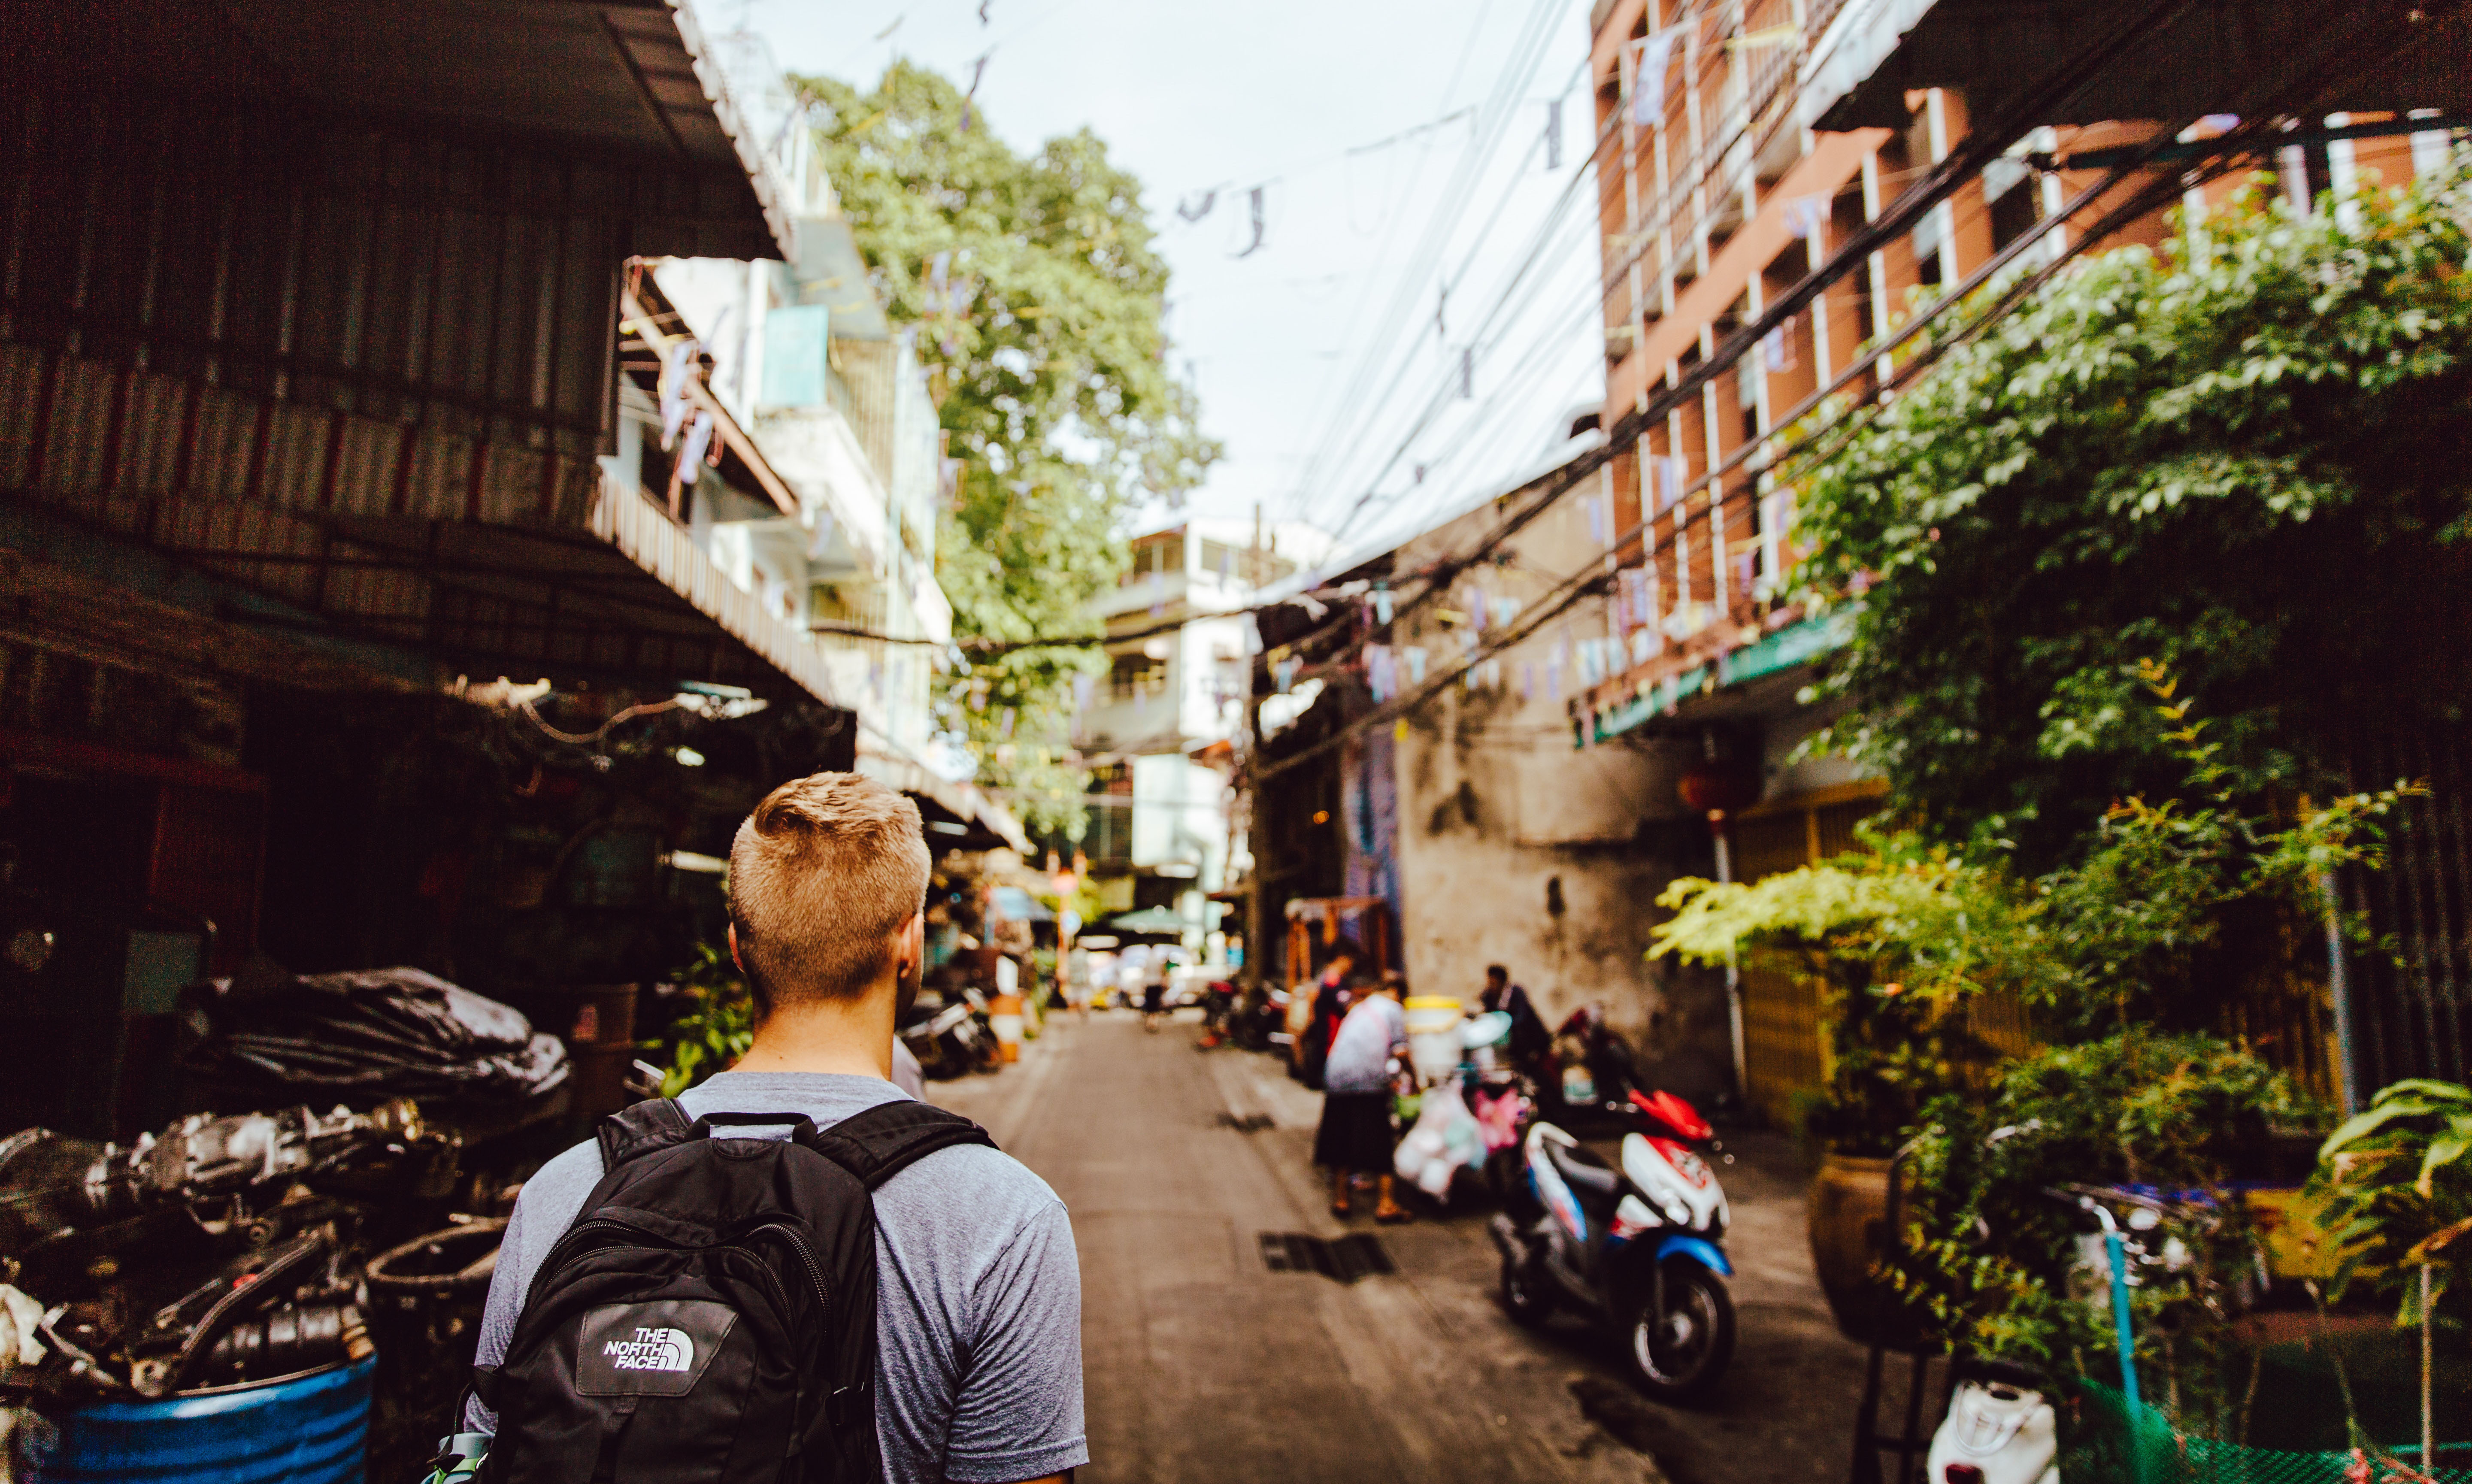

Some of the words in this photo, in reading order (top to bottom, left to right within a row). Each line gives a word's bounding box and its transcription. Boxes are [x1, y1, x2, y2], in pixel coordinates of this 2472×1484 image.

[636, 1327, 669, 1343] THE
[604, 1341, 665, 1356] NORTH
[615, 1355, 660, 1369] FACE
